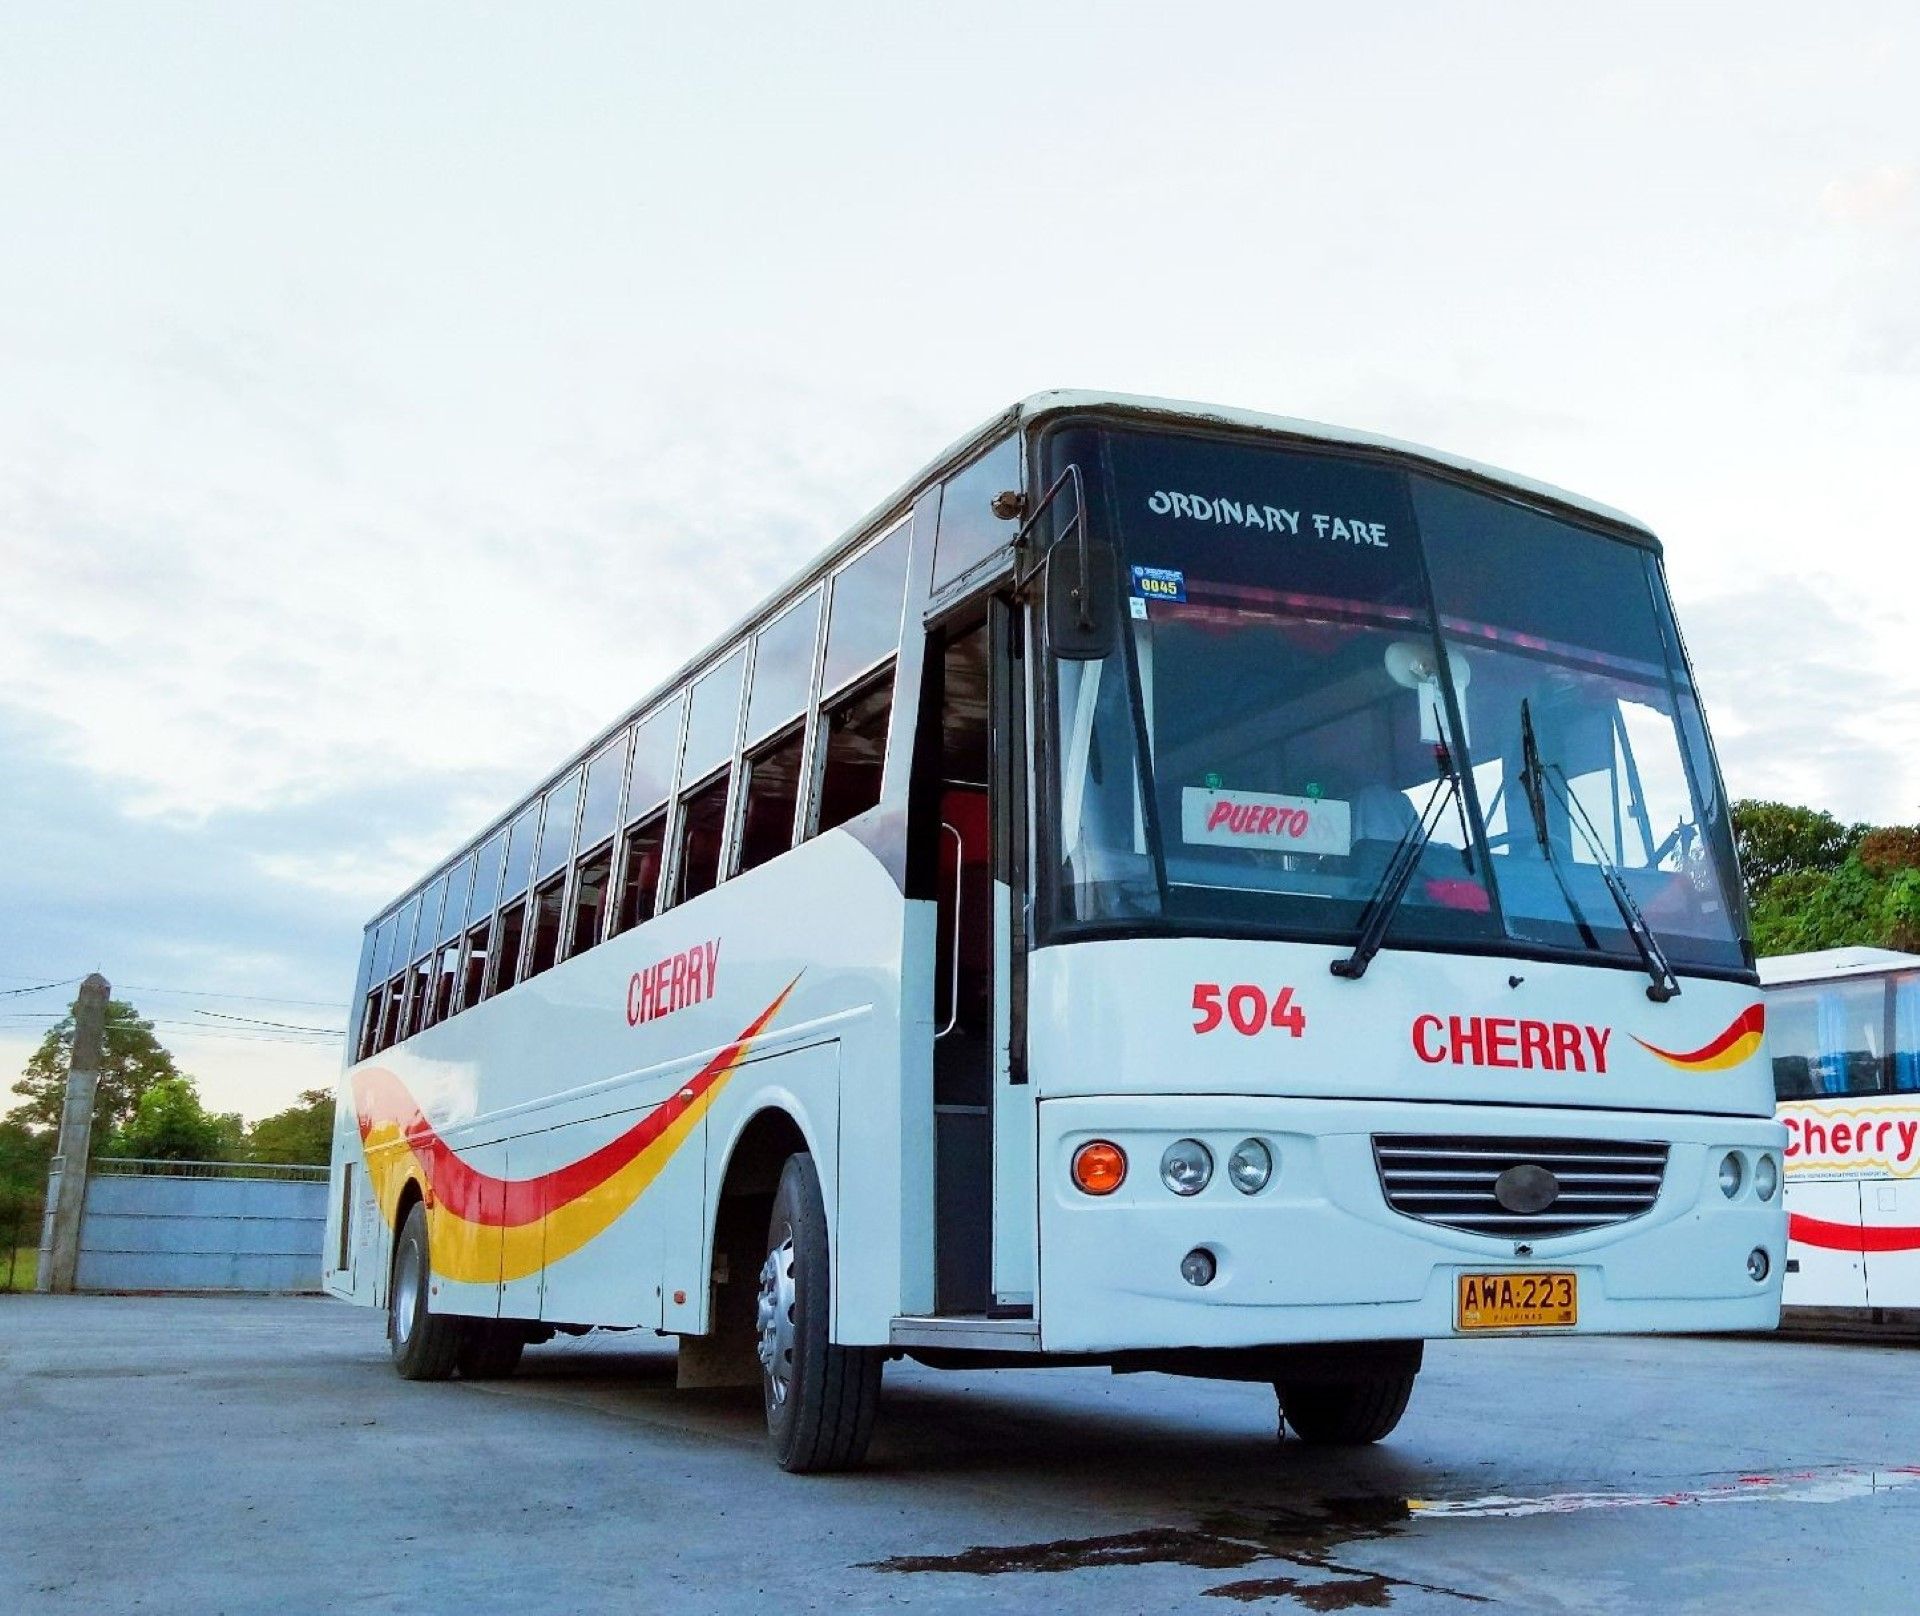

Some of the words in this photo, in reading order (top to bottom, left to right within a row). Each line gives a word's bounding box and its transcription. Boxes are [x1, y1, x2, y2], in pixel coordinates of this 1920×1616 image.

[1148, 490, 1299, 534] ORDINARY
[1312, 514, 1388, 547] FARE
[1141, 578, 1177, 595] 0045
[1207, 801, 1309, 838] PUERTO
[627, 937, 721, 1026] CHERRY
[1192, 984, 1305, 1037] 504
[1412, 1014, 1611, 1073] CHERRY
[1783, 1118, 1918, 1162] Cherry
